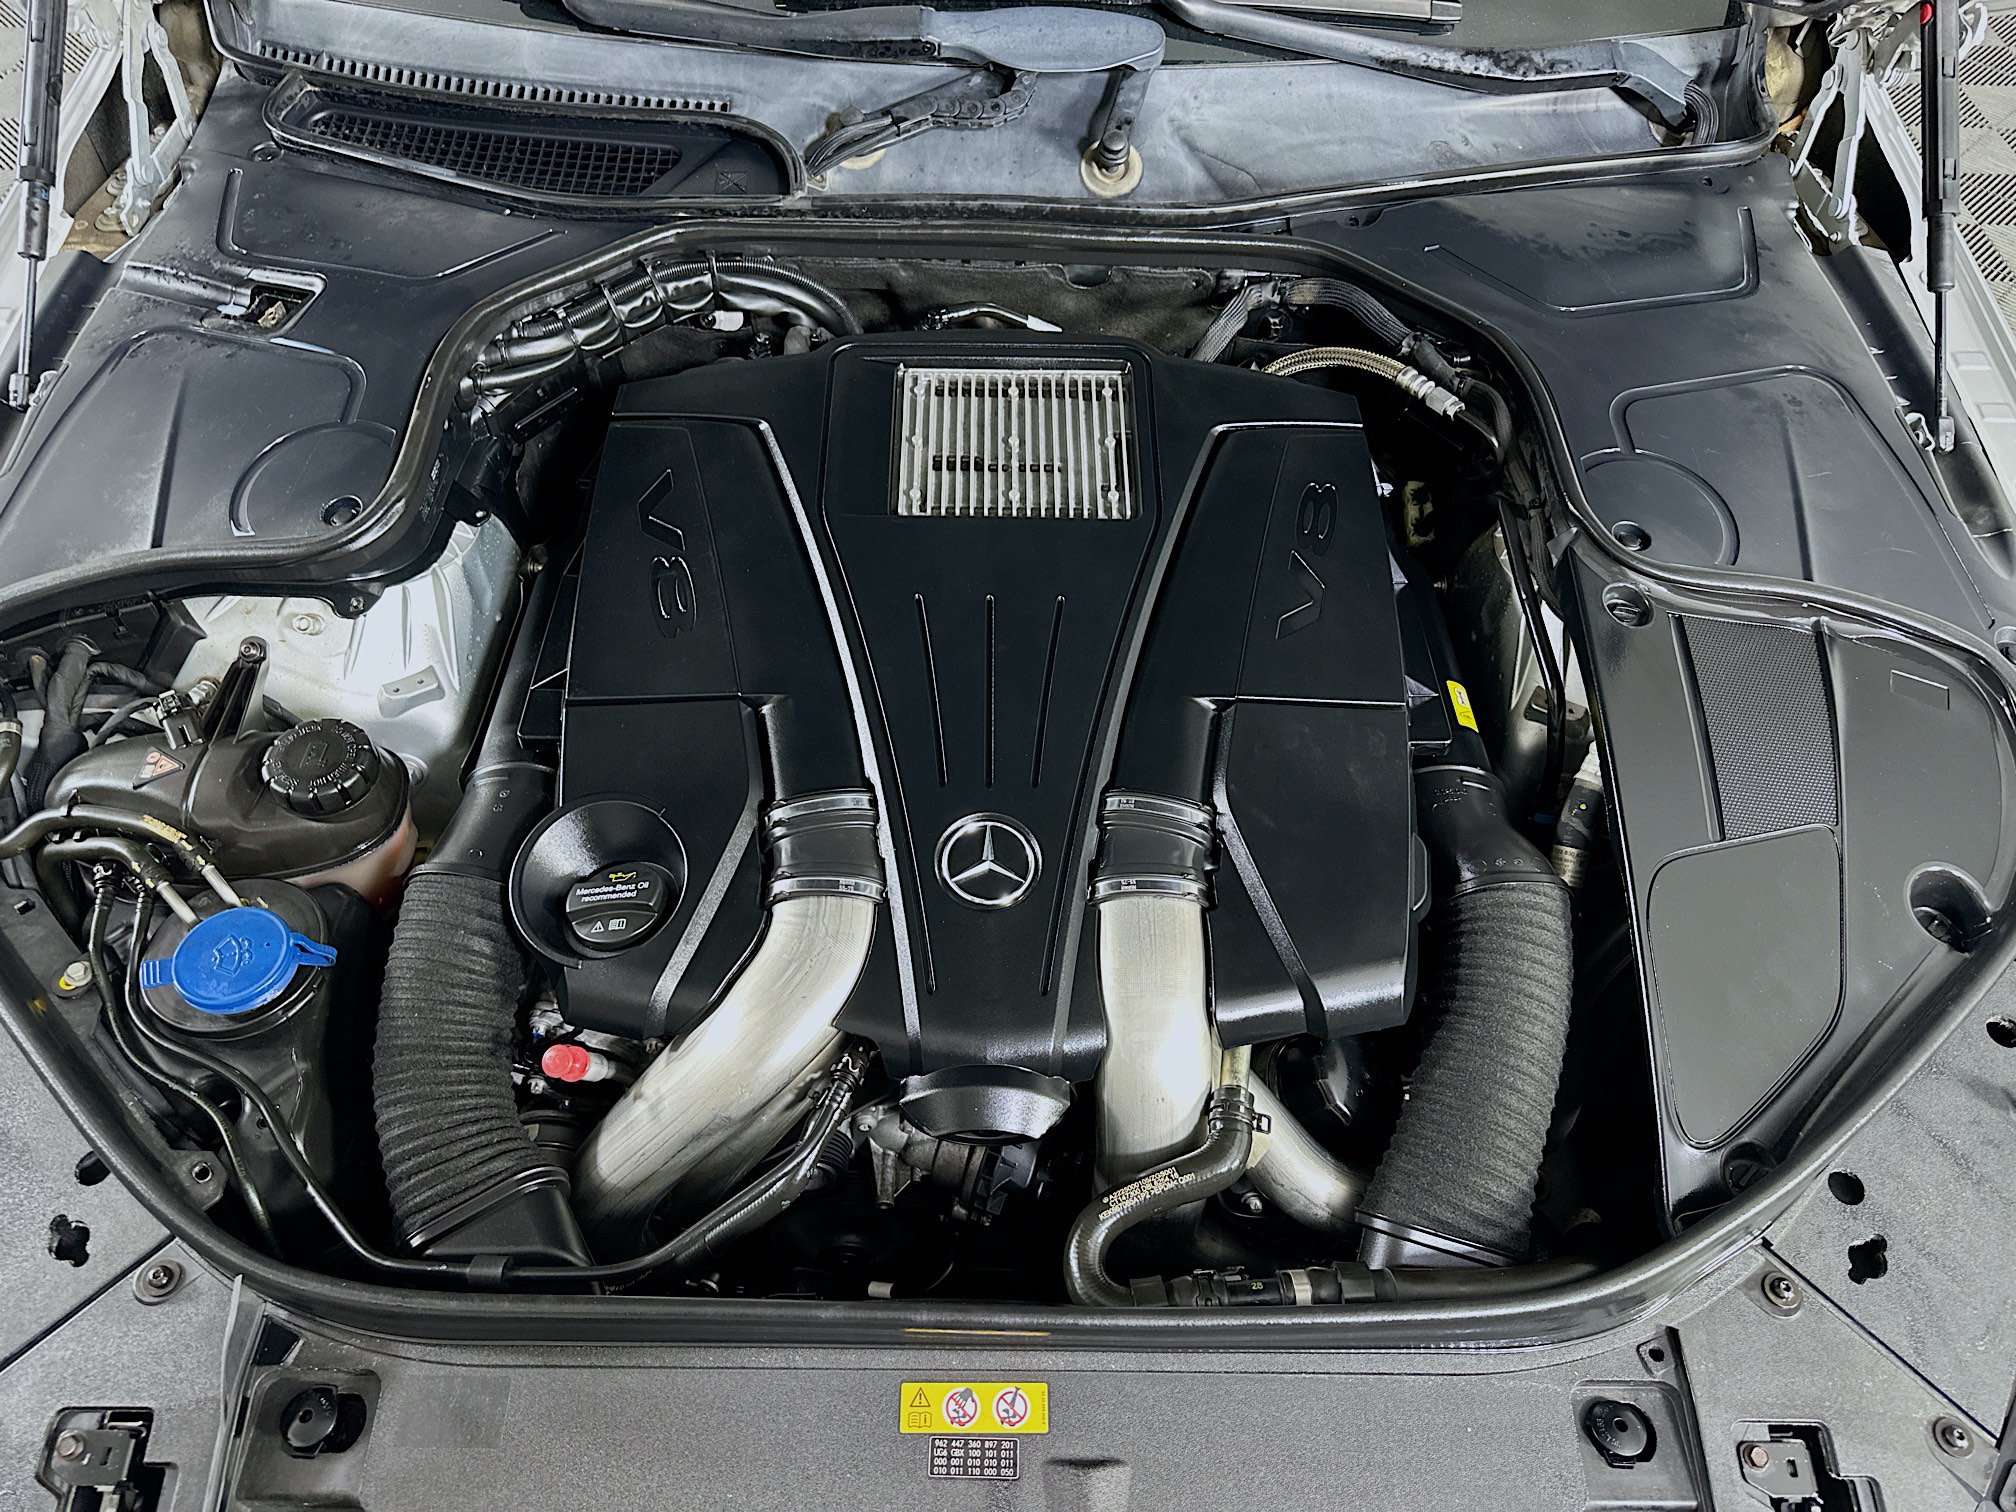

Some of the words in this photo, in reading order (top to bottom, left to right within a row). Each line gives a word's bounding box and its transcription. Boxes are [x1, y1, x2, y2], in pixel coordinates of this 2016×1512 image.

[637, 469, 697, 639] V8
[1276, 482, 1339, 639] V8
[576, 883, 636, 896] Mercedes-Benz
[637, 881, 650, 890] Oil
[581, 890, 637, 902] recommended
[935, 1439, 947, 1447] 962
[1001, 1441, 1013, 1449] 201
[1001, 1450, 1013, 1458] 011
[951, 1458, 963, 1466] 001
[1001, 1459, 1013, 1467] 011
[951, 1467, 963, 1475] 011
